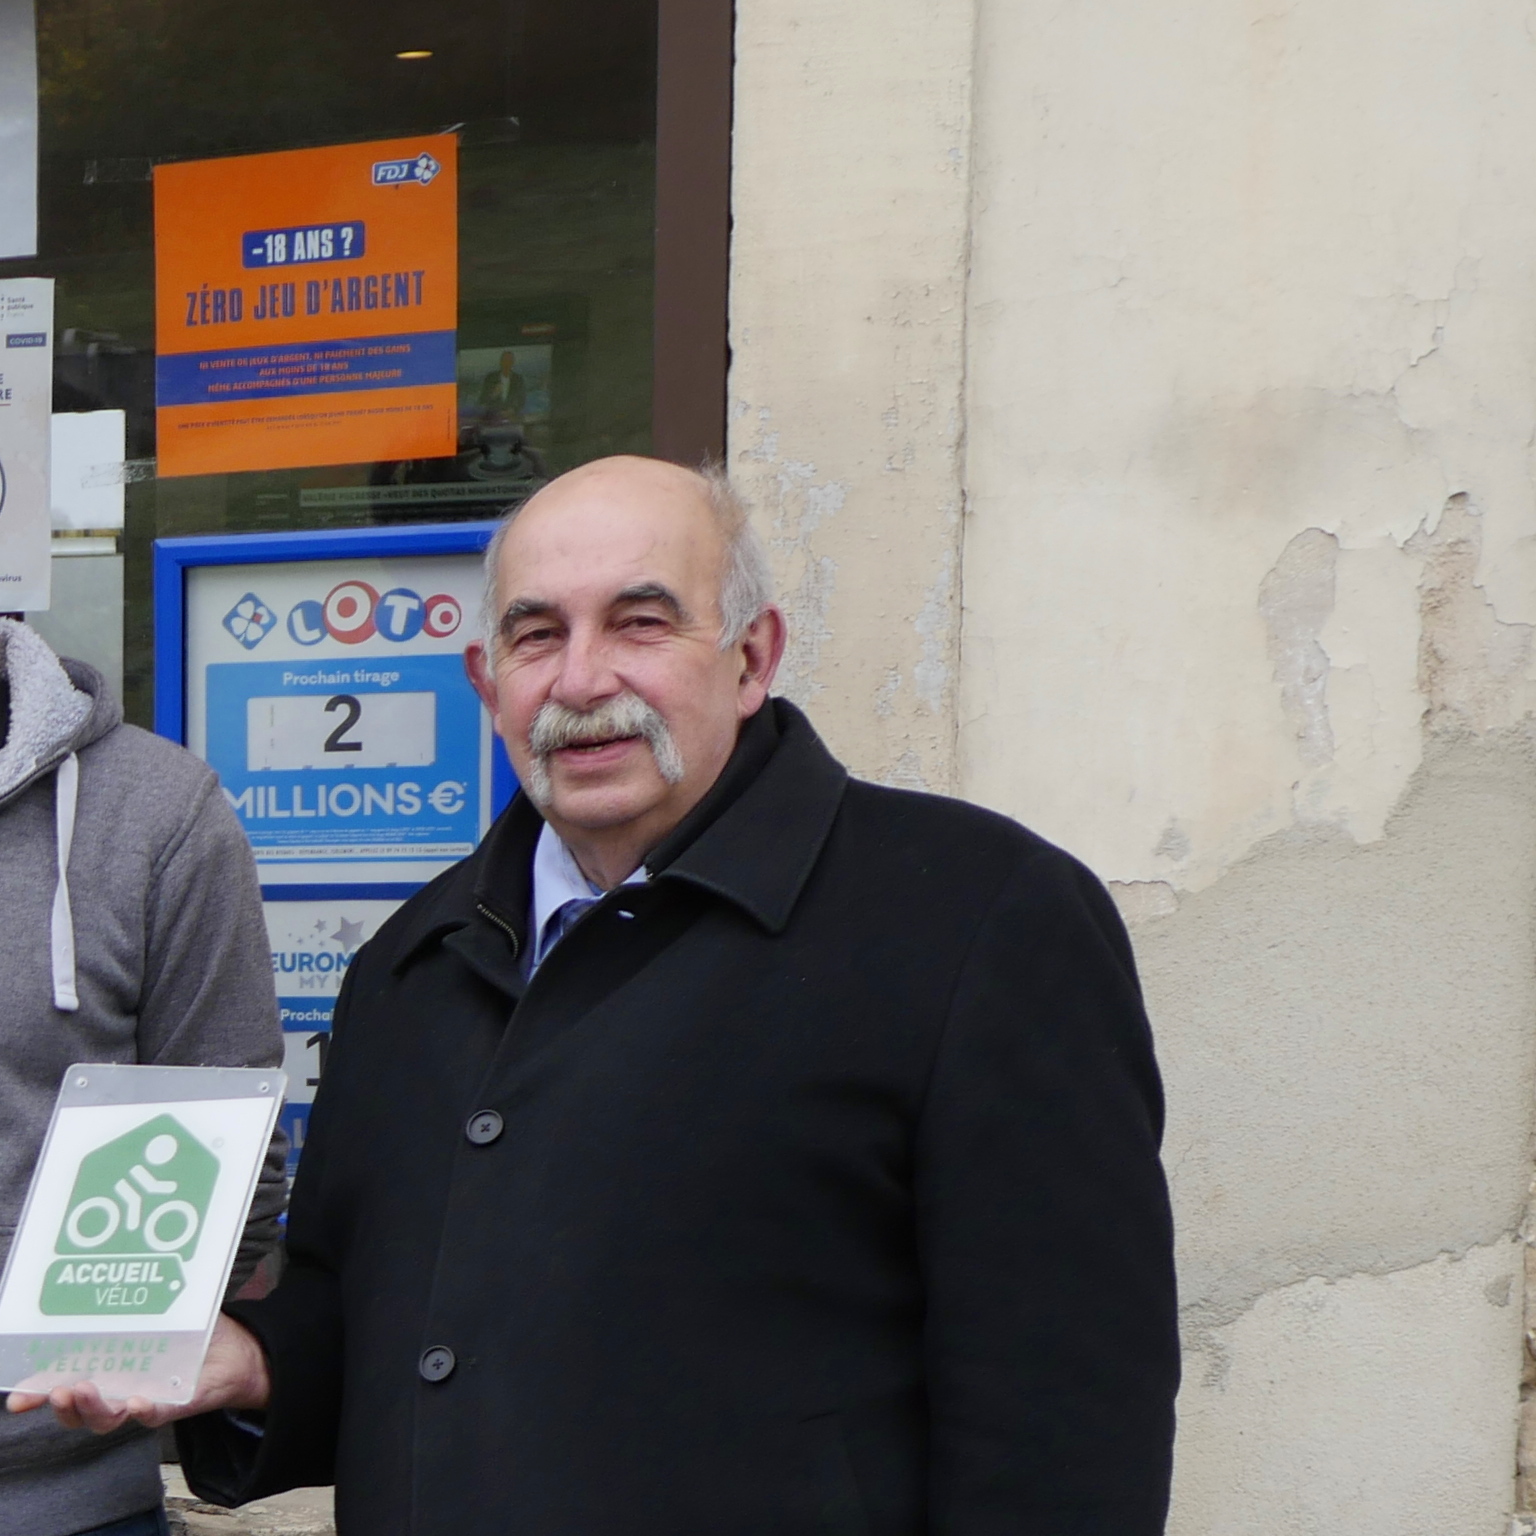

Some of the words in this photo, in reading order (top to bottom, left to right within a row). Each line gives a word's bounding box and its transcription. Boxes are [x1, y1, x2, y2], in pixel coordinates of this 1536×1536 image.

[376, 163, 408, 181] FDJ
[252, 234, 286, 264] -18
[294, 229, 334, 261] ANS
[341, 227, 353, 257] ?
[185, 281, 243, 327] ZÉRO
[253, 282, 296, 320] JEU
[306, 270, 426, 315] D'ARGENT
[210, 360, 236, 370] VENTE
[237, 358, 248, 368] DE
[249, 356, 269, 367] JEUX
[325, 348, 366, 360] PAIEMENT
[367, 347, 383, 356] DES
[385, 344, 410, 354] GAINS
[259, 367, 277, 377] AUX
[279, 365, 304, 375] MOINS
[306, 364, 318, 373] DE
[334, 361, 348, 371] ANS
[319, 372, 363, 384] PERSONNE
[365, 369, 402, 380] MAJEURE
[289, 581, 462, 645] LOTO
[282, 670, 349, 687] Prochain
[352, 669, 400, 687] tirage
[323, 694, 363, 753] 2
[225, 782, 422, 820] MILLIONS
[272, 952, 359, 973] EUROM
[299, 975, 328, 989] MY
[280, 1008, 335, 1021] Prochai
[56, 1262, 164, 1284] ACCUEIL
[95, 1282, 149, 1305] VÉLO
[28, 1337, 170, 1354] BIENVENUE
[34, 1355, 154, 1373] WELCOME
